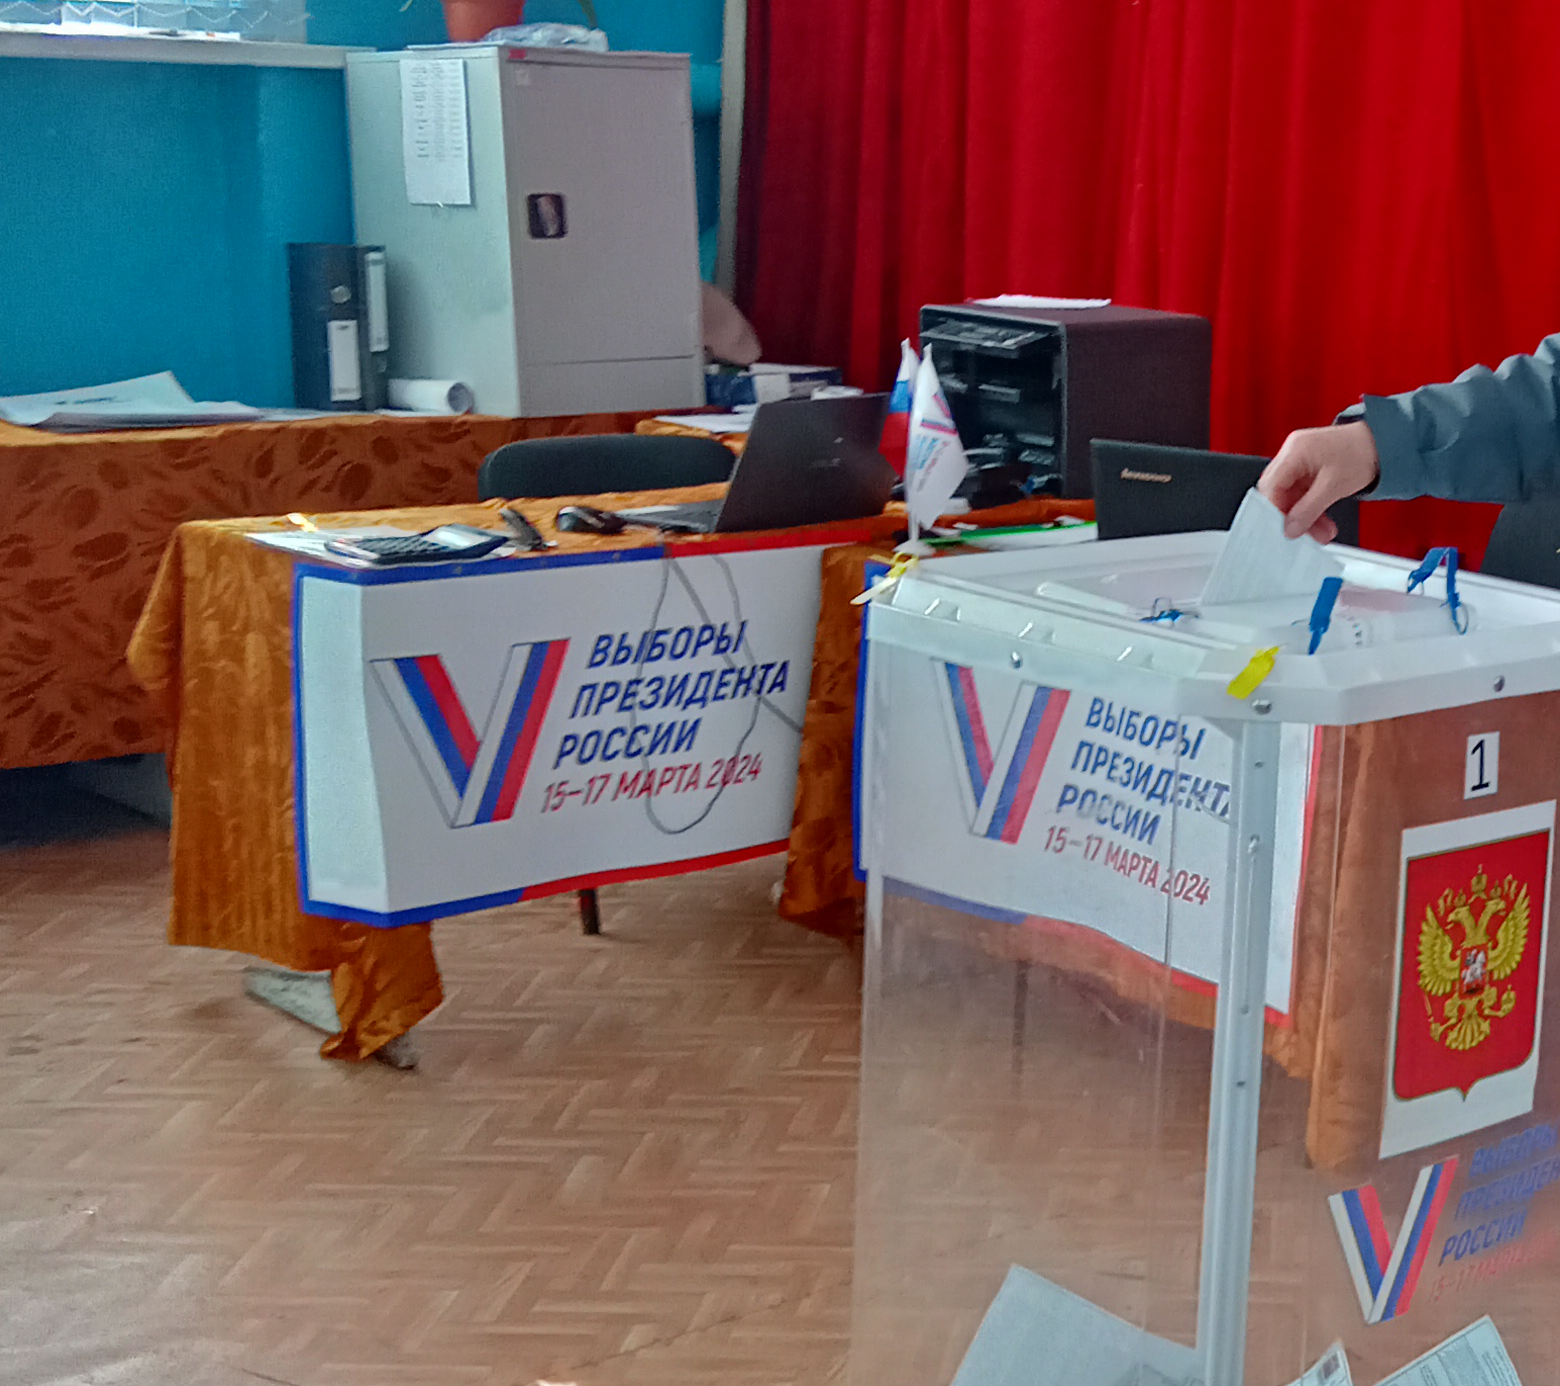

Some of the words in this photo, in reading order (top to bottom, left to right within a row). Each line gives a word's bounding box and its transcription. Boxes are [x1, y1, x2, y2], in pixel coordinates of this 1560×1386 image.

[587, 620, 748, 669] ВЫБОРЫ
[568, 660, 791, 719] ПРЕЗИДЕНТА
[553, 717, 704, 770] РОССИИ
[1084, 696, 1206, 760] ВЫБОРЫ
[611, 762, 701, 802] МАРТА
[704, 751, 764, 790] 2024
[1470, 739, 1491, 792] 1
[1056, 783, 1161, 846] РОССИИ
[1104, 839, 1160, 889] МАРТА
[1159, 866, 1212, 906] 2024
[1438, 1209, 1528, 1268] РОССИИ
